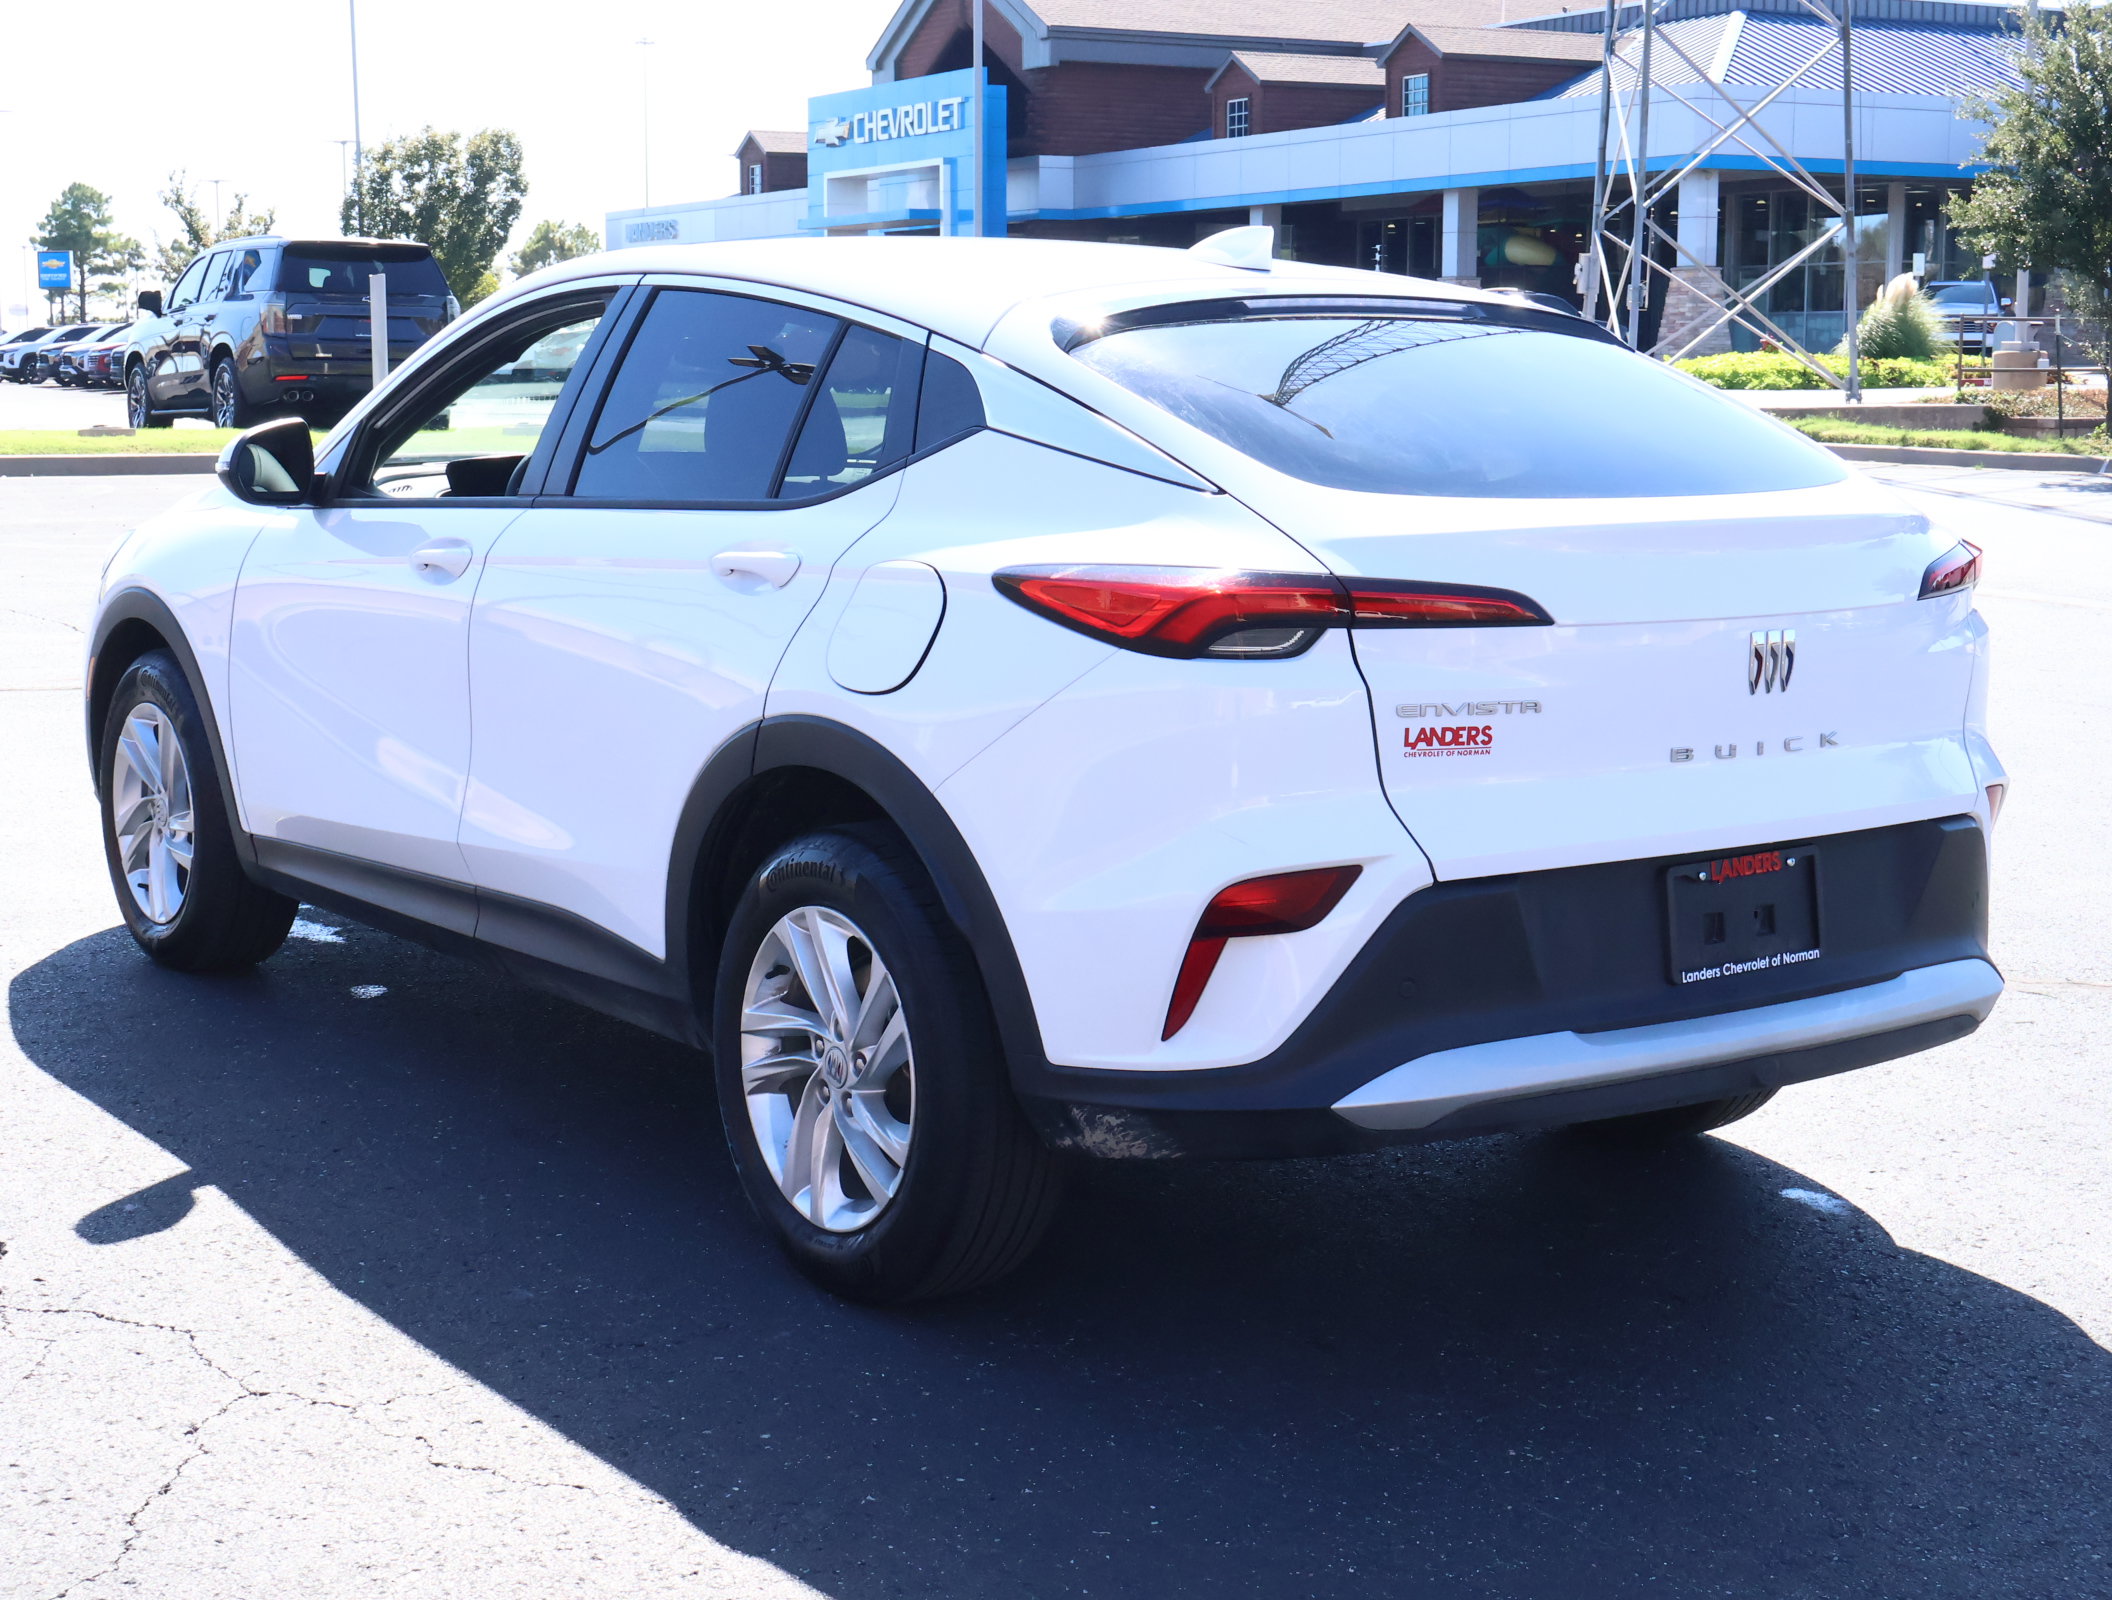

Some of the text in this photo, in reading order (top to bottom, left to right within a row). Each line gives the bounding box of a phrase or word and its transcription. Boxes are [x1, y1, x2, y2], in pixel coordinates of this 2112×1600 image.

[853, 96, 964, 144] CHEVROLET
[1395, 699, 1542, 718] ENVISTA
[1403, 725, 1493, 750] LANDERS
[1403, 750, 1444, 758] CHEVROLET
[1457, 749, 1491, 757] NORMAN
[1669, 730, 1839, 763] BUICK
[1711, 851, 1782, 883] LANDERS
[1682, 949, 1820, 983] Landers Chevrolet of Norman
